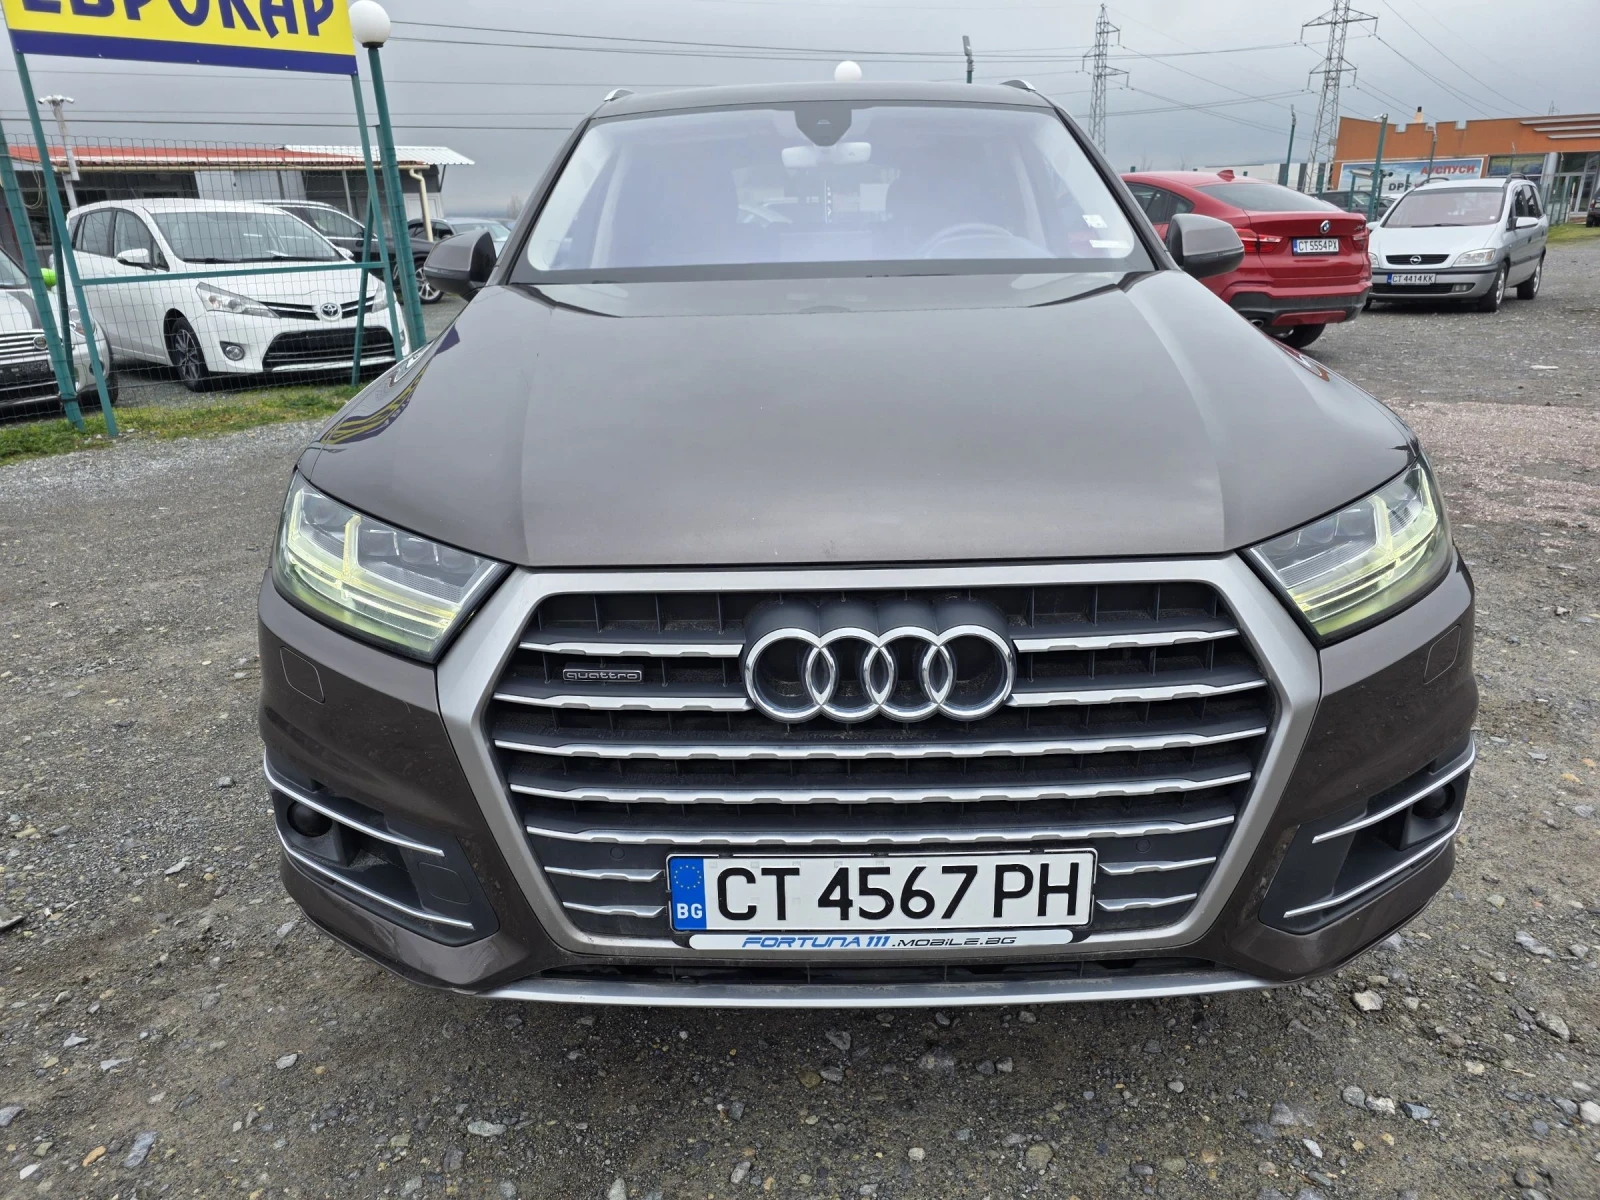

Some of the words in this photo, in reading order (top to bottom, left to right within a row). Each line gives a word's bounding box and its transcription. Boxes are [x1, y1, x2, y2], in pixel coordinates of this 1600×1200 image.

[1310, 240, 1327, 251] 5554
[1403, 275, 1422, 283] 4414
[566, 671, 638, 680] quattro
[716, 866, 801, 921] CT
[817, 864, 979, 921] 4567
[992, 861, 1080, 919] PH
[677, 902, 703, 919] BG
